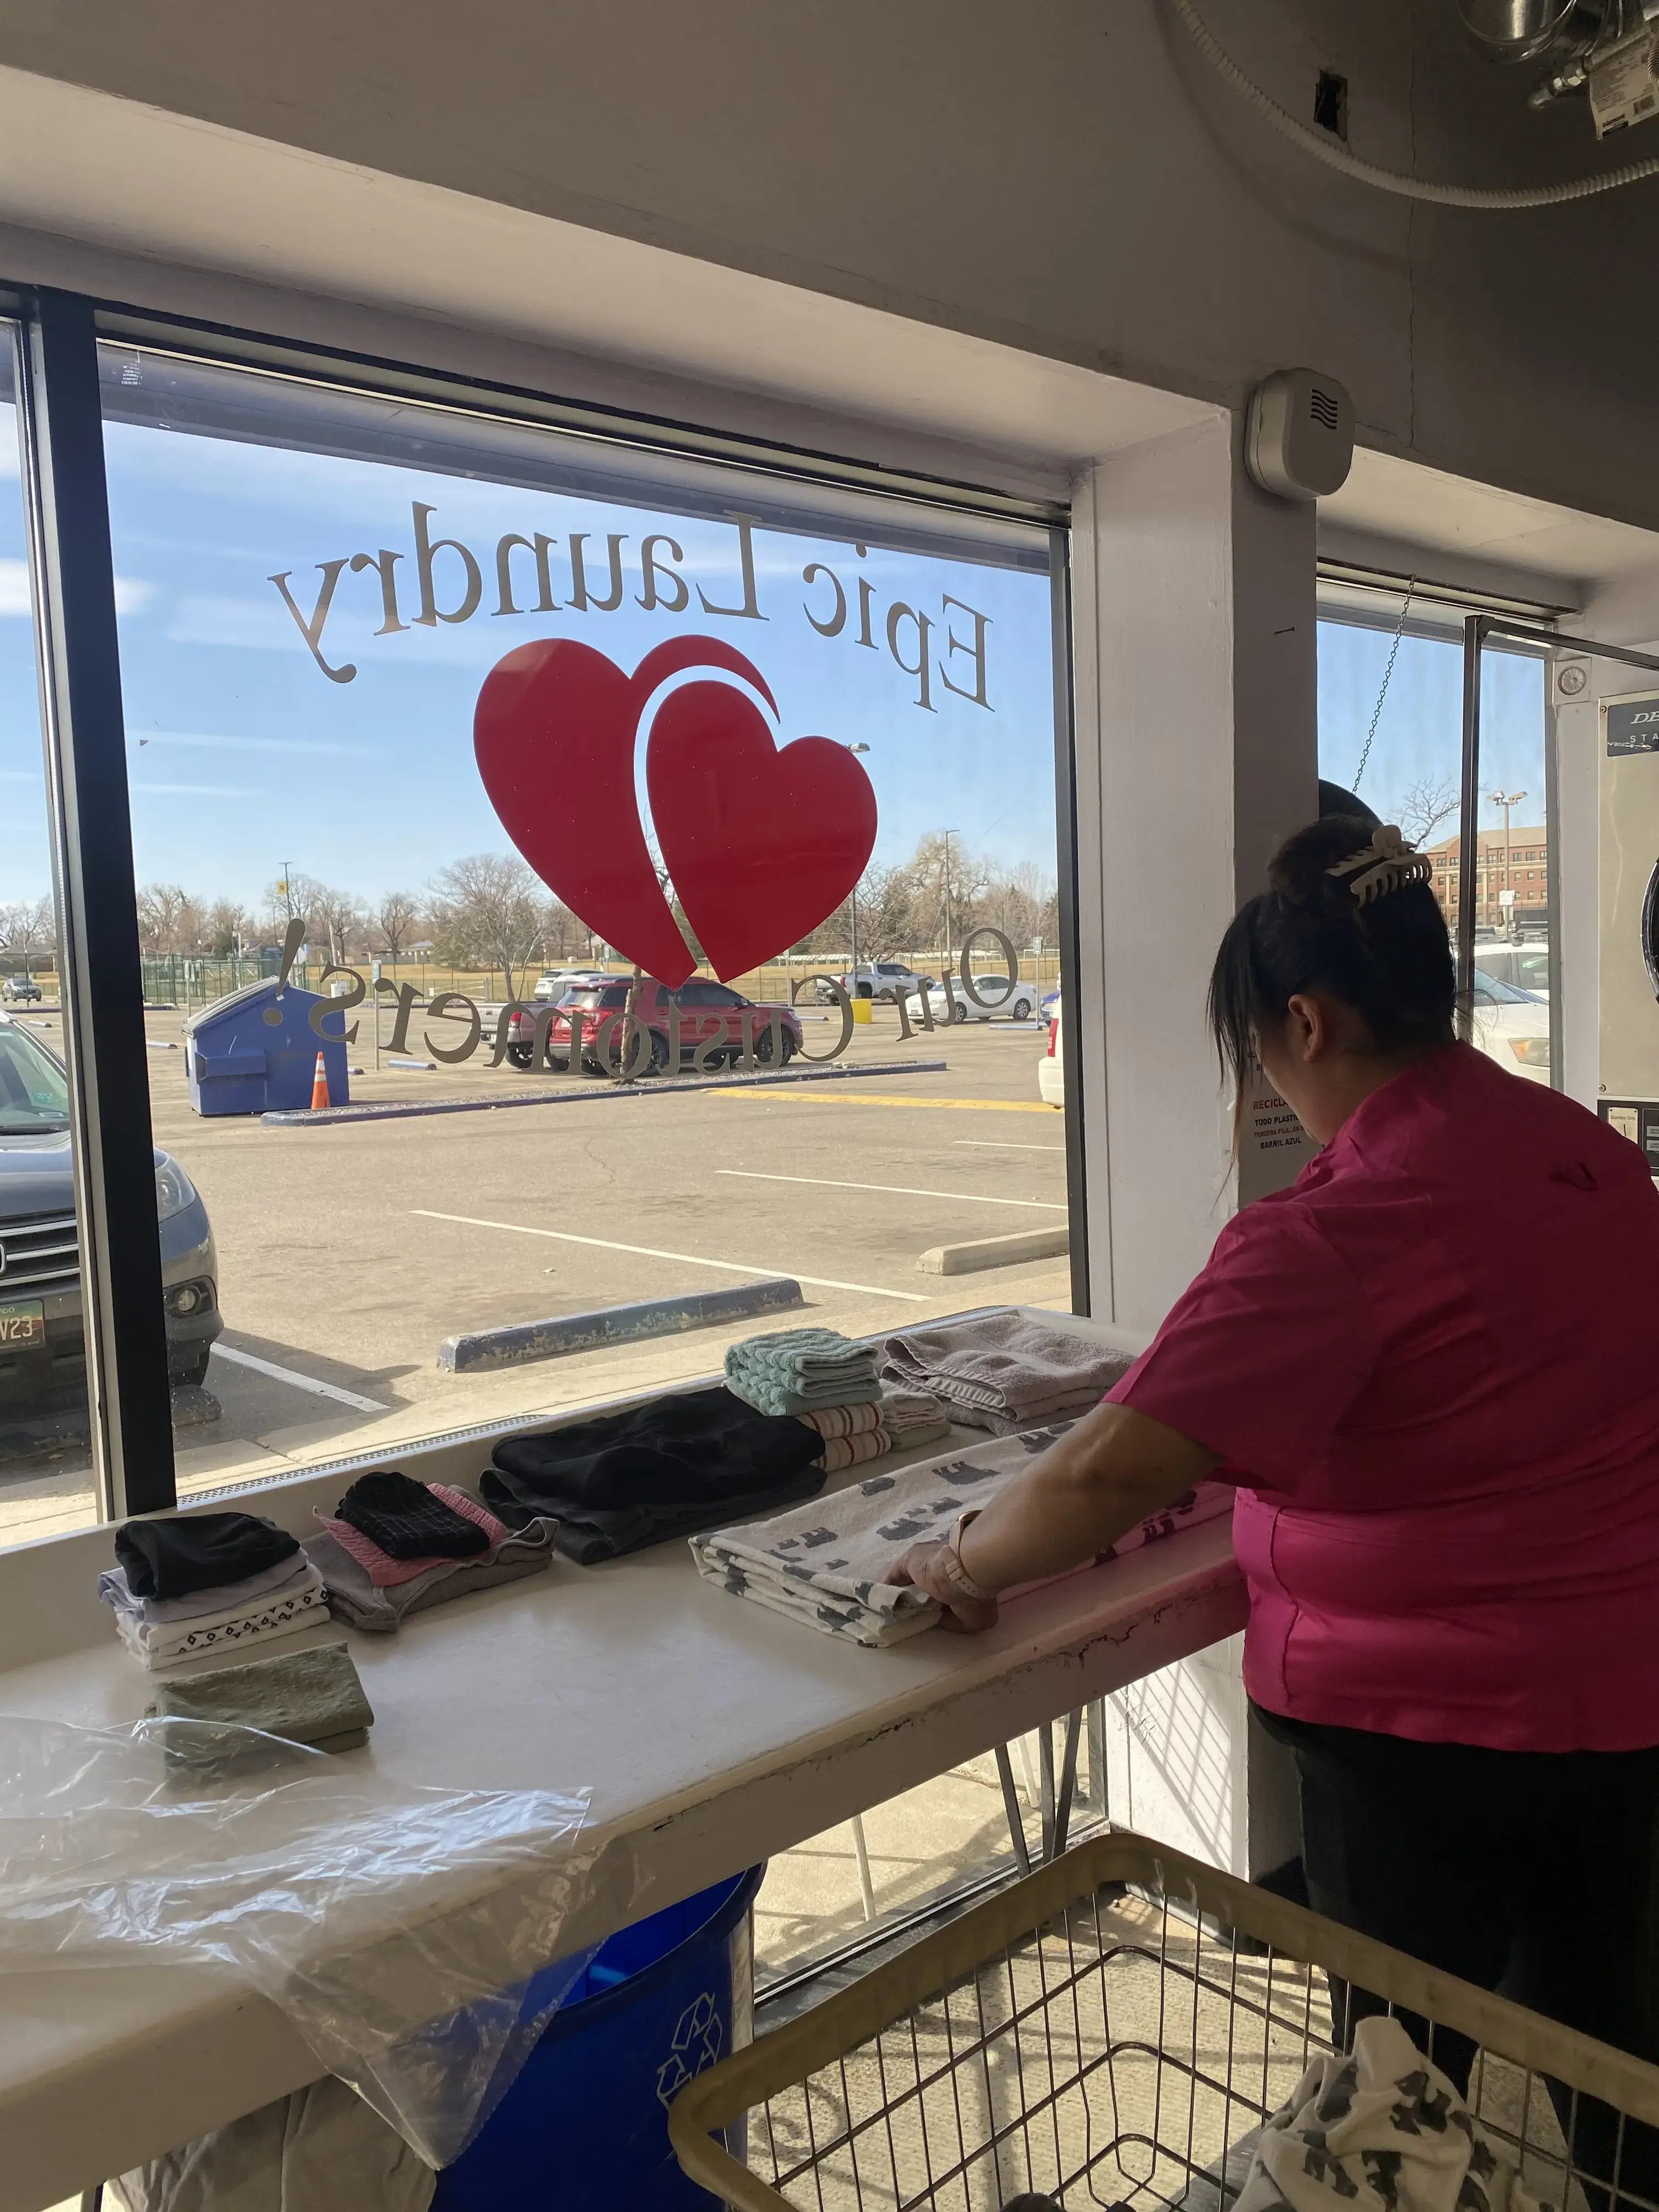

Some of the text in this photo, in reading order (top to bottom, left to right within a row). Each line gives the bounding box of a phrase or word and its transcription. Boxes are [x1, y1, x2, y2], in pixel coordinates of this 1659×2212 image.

[1255, 1117, 1272, 1126] TODO
[1254, 1129, 1277, 1138] TERCERA
[1260, 1137, 1301, 1149] BARRIL AZUL
